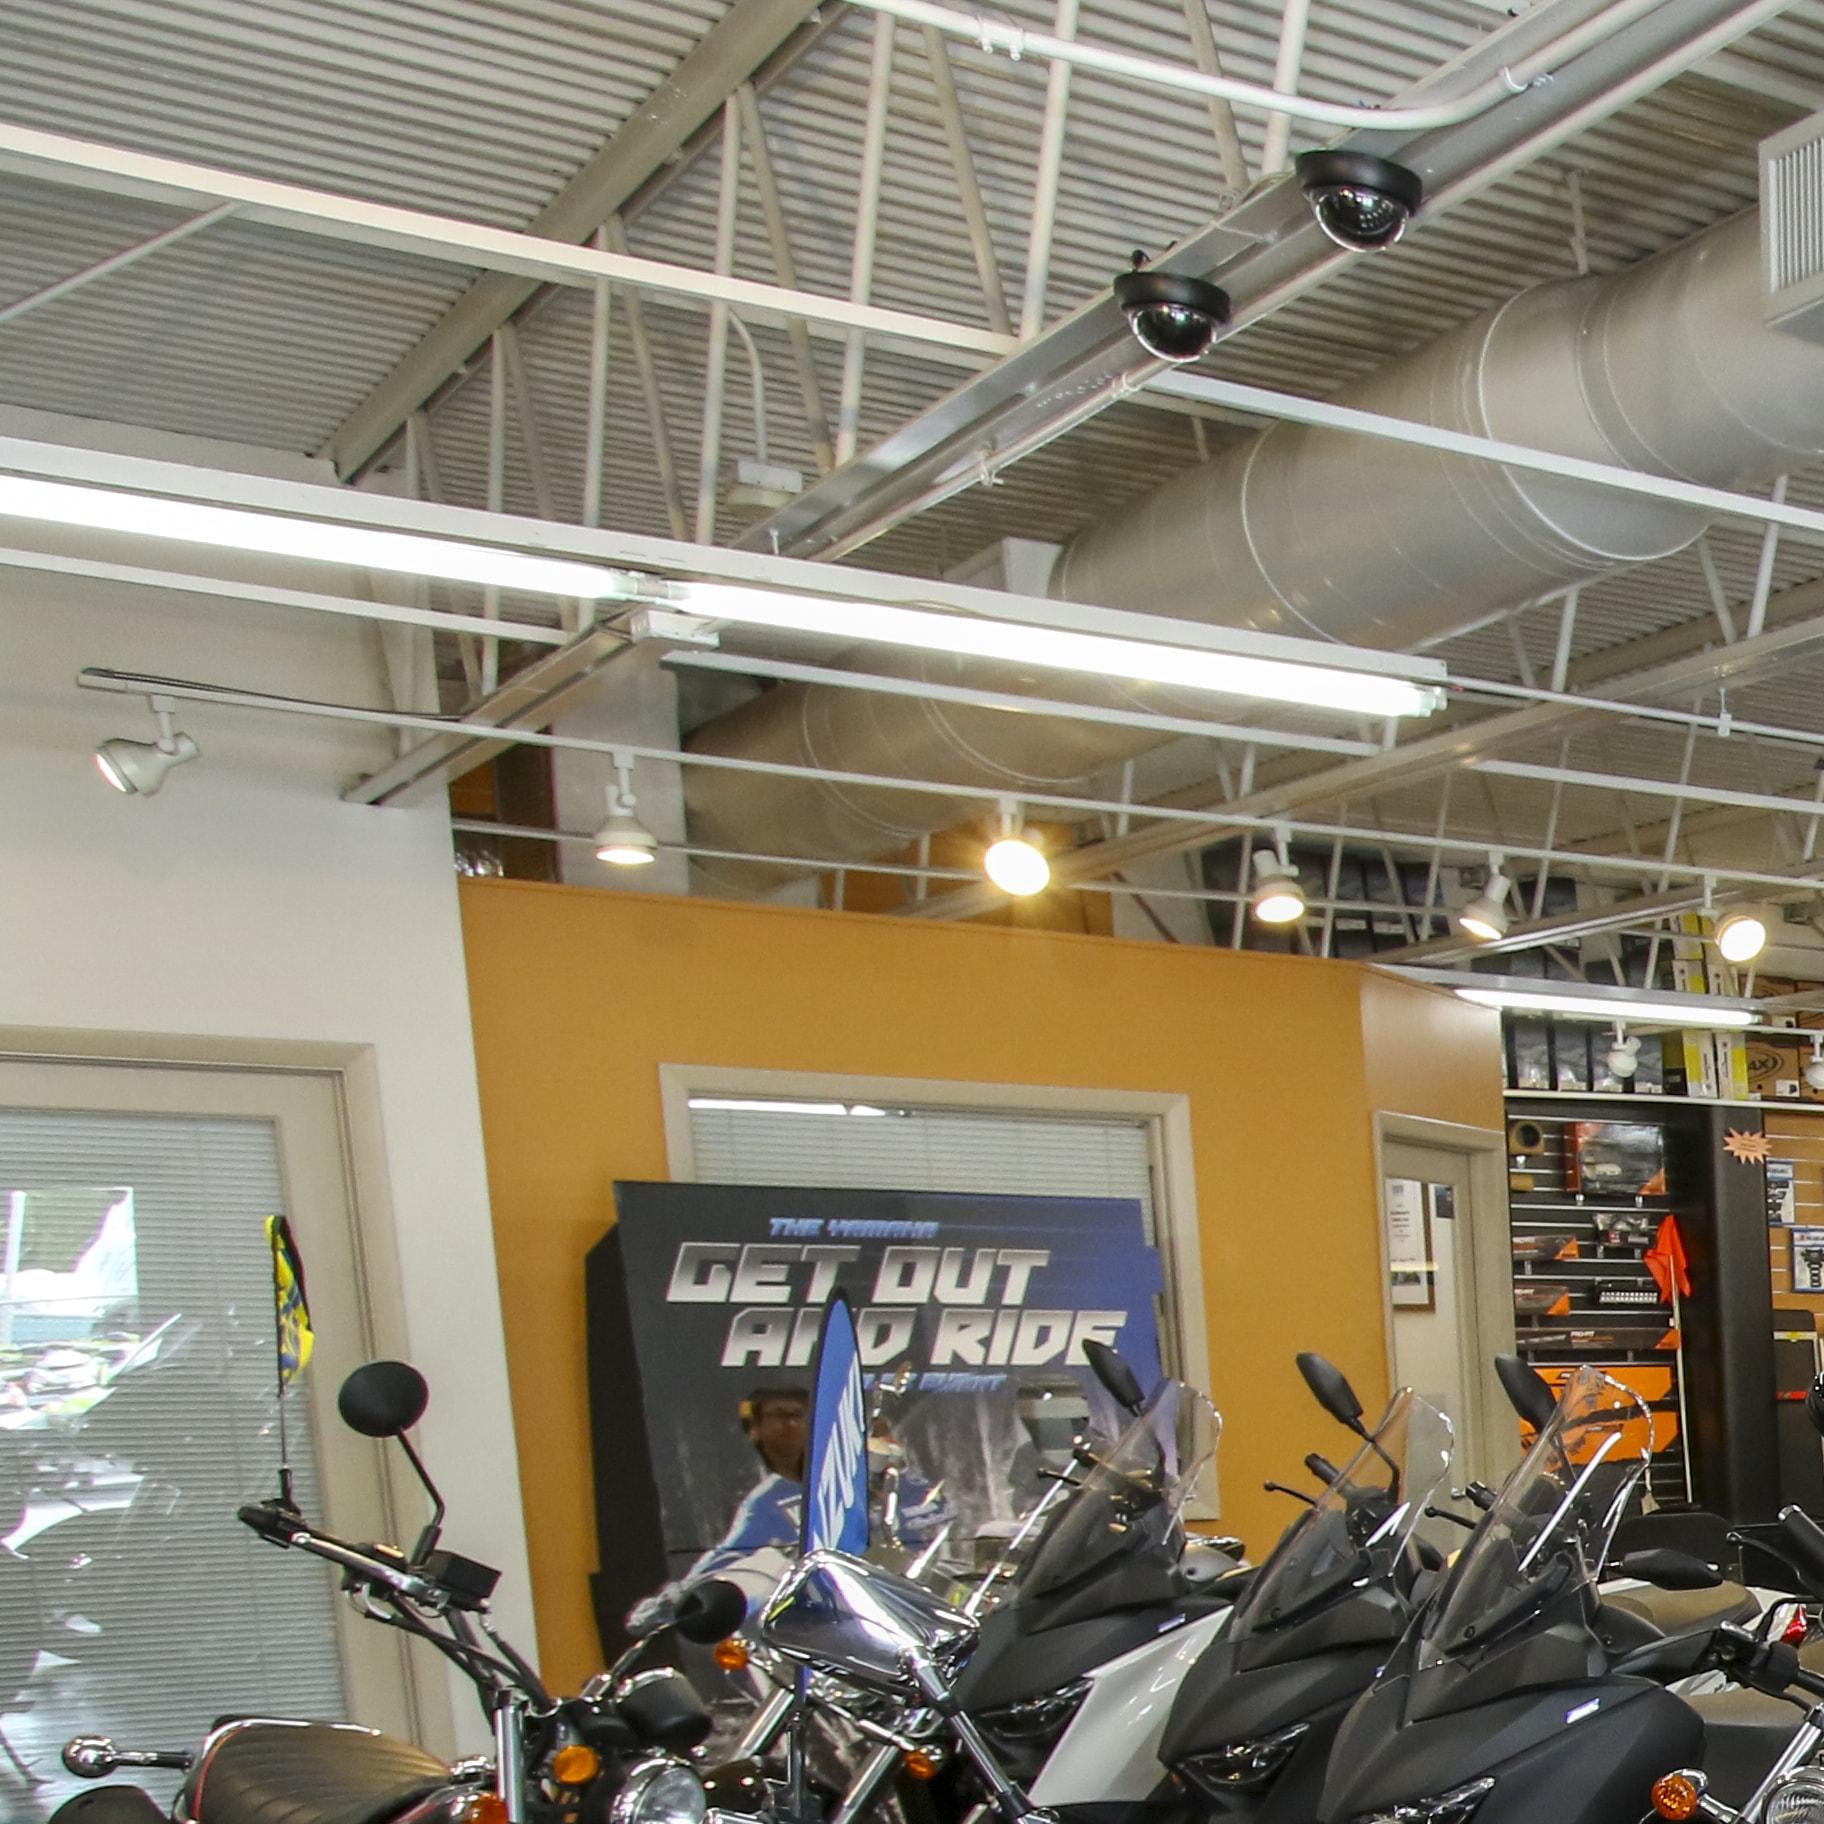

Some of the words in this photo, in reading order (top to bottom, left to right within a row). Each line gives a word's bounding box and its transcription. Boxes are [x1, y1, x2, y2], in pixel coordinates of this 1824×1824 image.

[768, 1217, 824, 1237] THE
[666, 1241, 861, 1303] GET
[871, 1246, 1051, 1306] OUT
[930, 1309, 1128, 1367] RIDE
